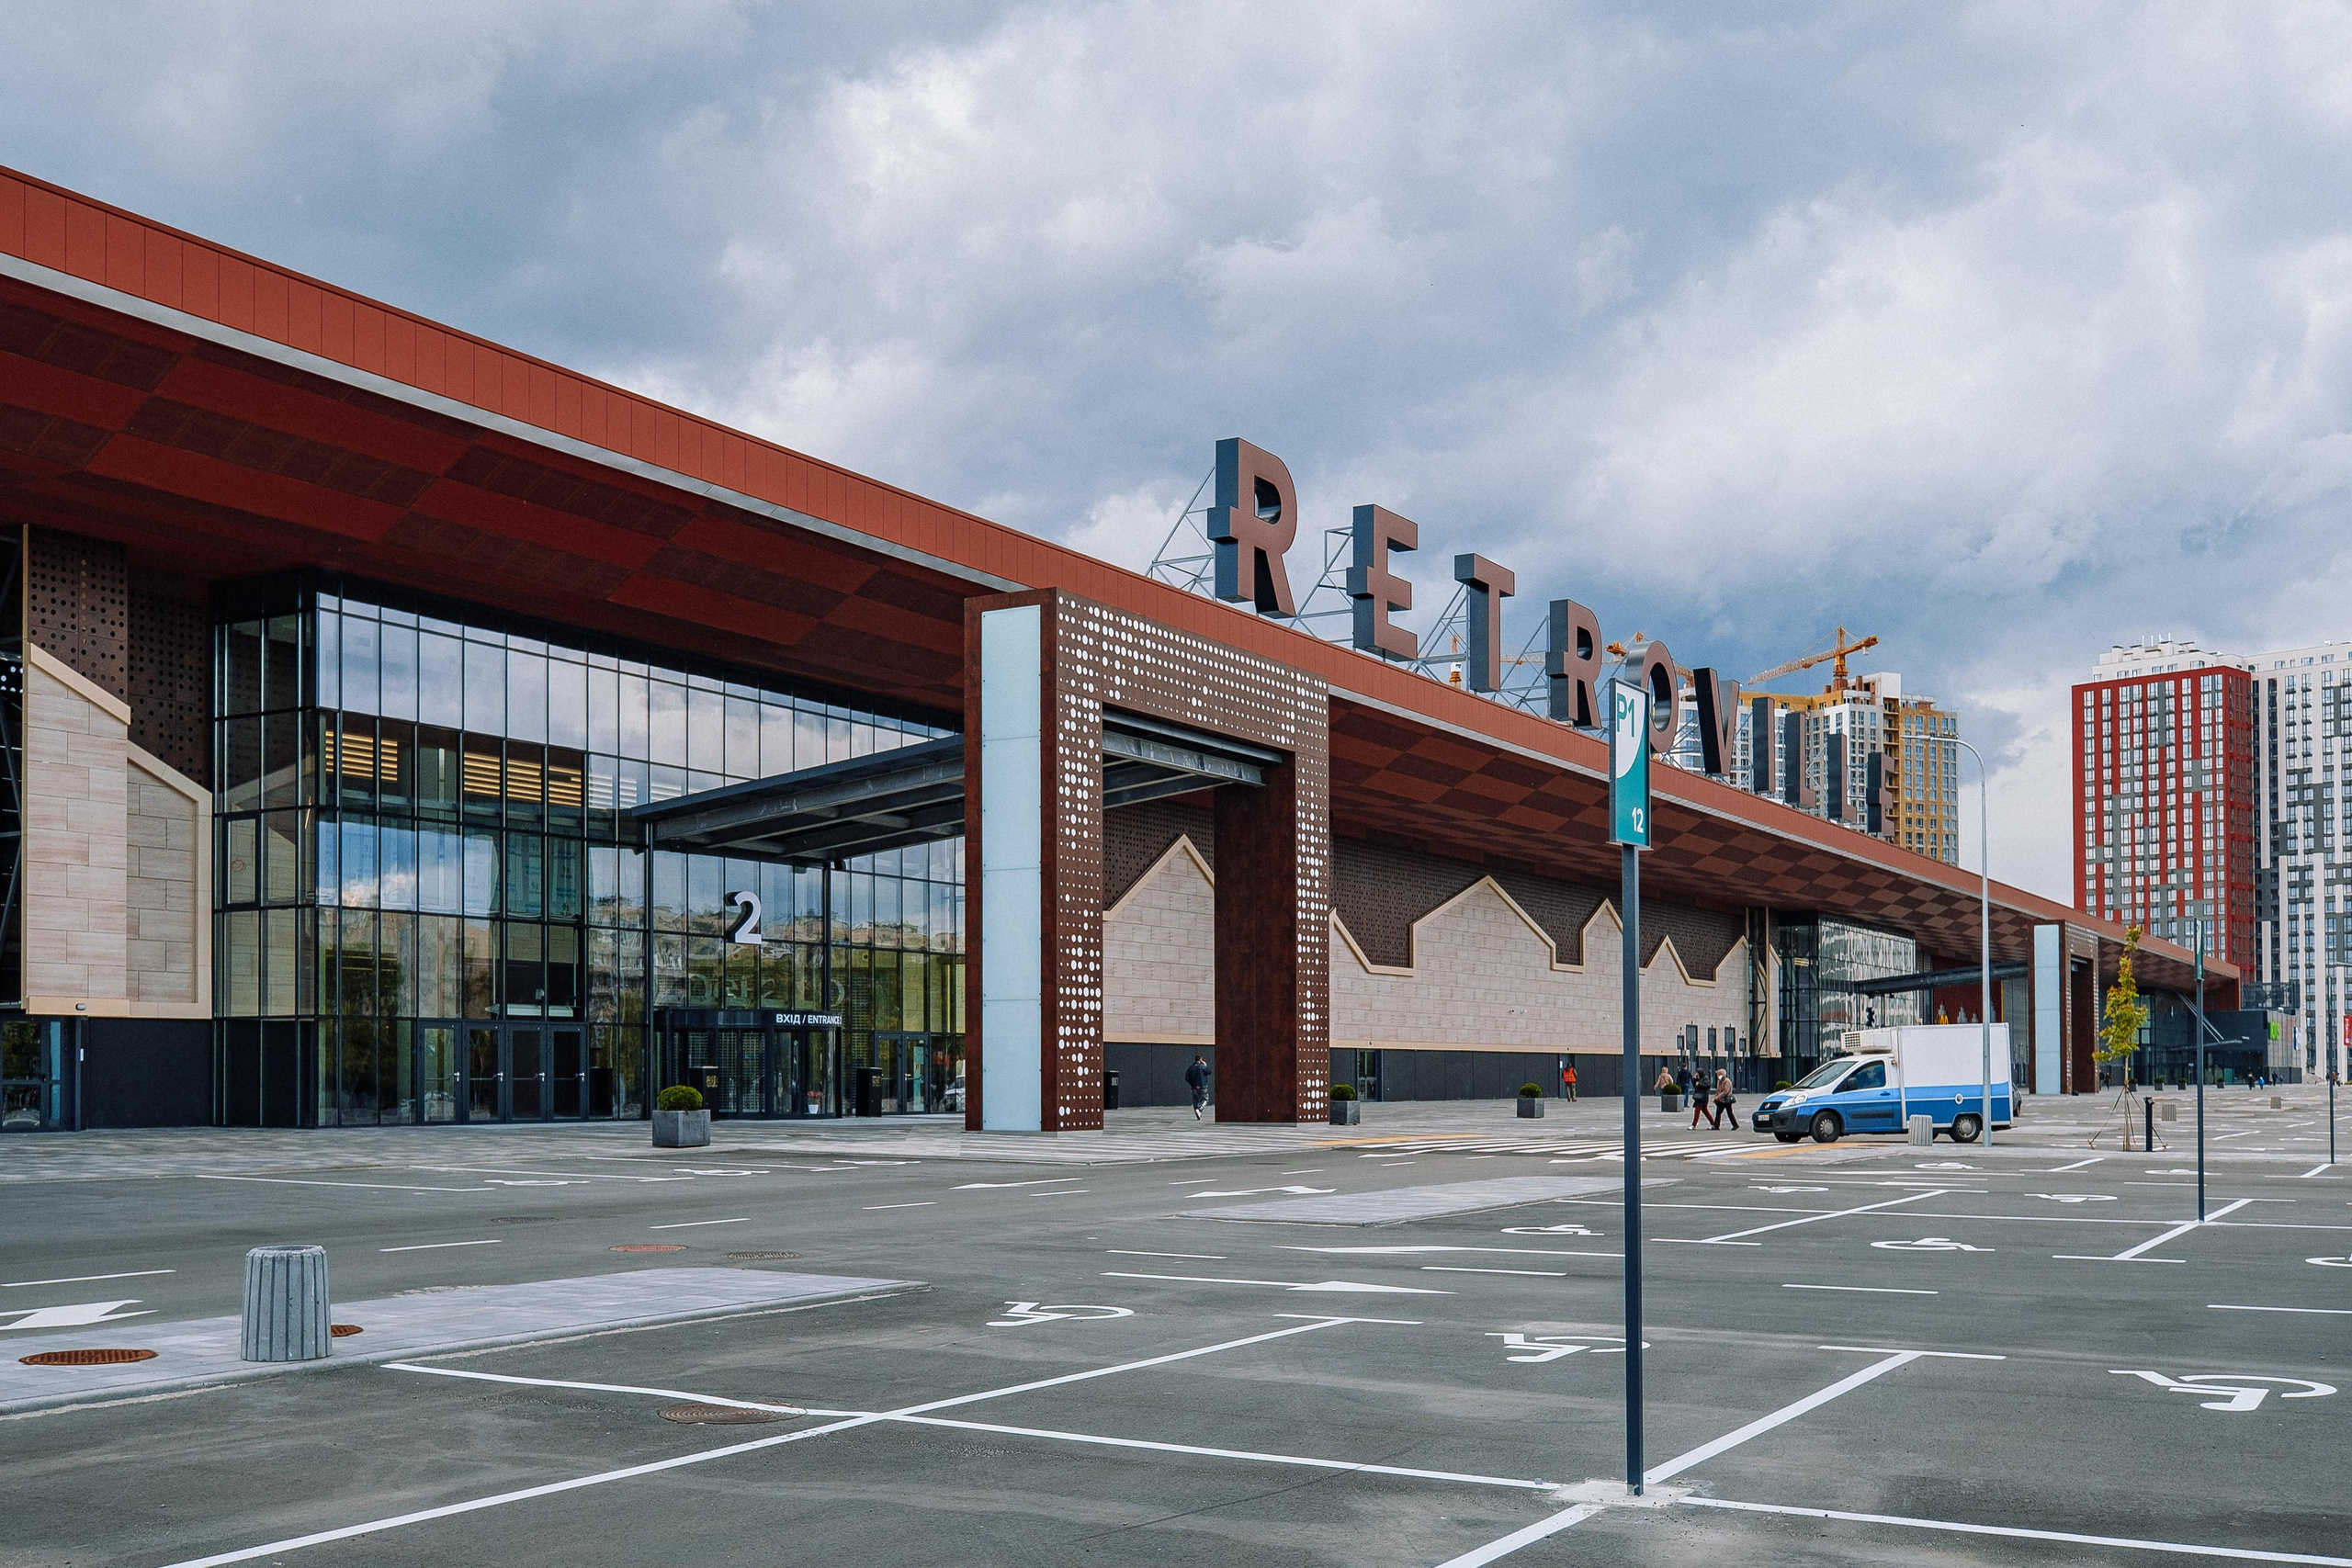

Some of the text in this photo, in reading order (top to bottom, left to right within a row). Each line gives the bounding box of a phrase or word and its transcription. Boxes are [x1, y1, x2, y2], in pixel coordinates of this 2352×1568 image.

[1207, 437, 1895, 837] RETROVILLE
[1616, 693, 1635, 738] P1
[1632, 807, 1644, 834] 12
[734, 890, 762, 944] 2
[775, 1013, 801, 1025] ВХІД
